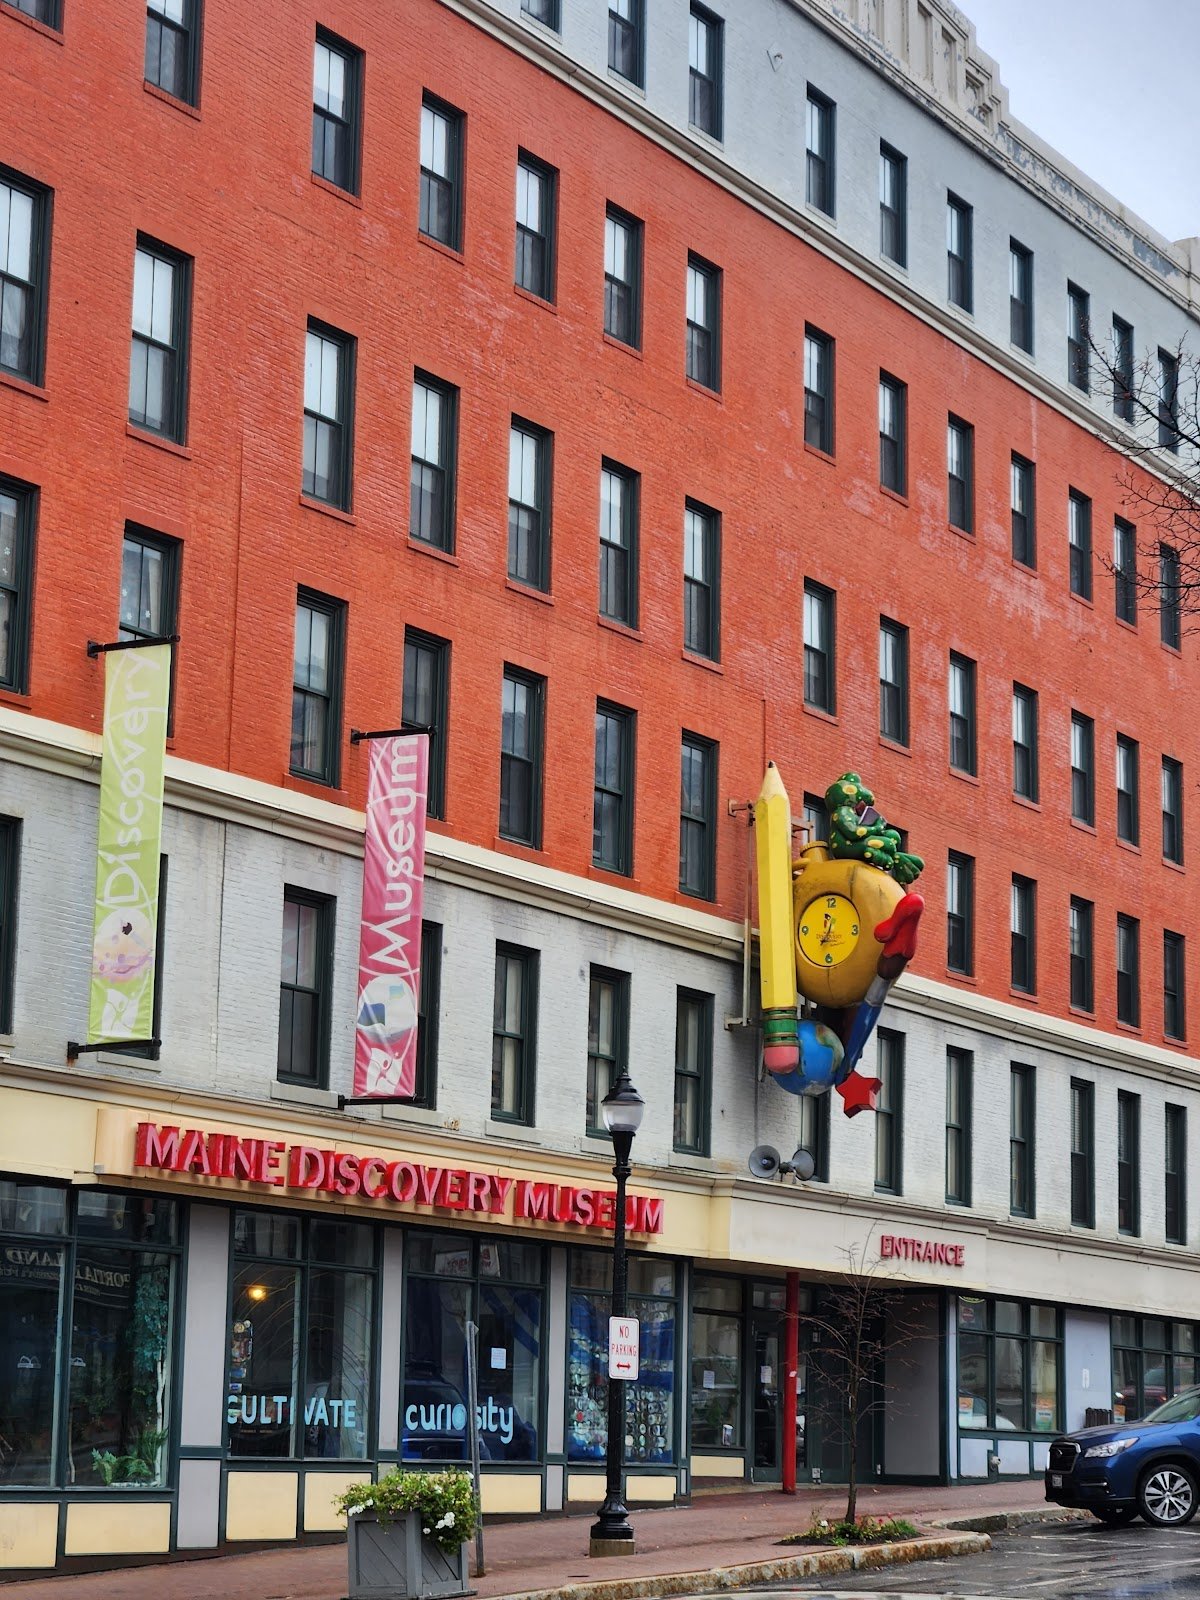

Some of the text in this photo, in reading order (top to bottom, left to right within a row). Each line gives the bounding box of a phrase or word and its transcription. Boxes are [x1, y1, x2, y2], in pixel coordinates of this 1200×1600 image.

[103, 650, 161, 906] Discovery
[368, 735, 418, 970] Museum
[826, 897, 837, 909] 12
[801, 925, 809, 936] 9
[851, 924, 859, 936] 3
[825, 953, 833, 964] 6
[134, 1121, 664, 1234] MAINE DISCOVERY MUSEUM
[881, 1234, 965, 1267] ENTRANCE
[618, 1325, 630, 1339] NO
[611, 1343, 637, 1357] PARKING
[227, 1394, 357, 1428] CULTIVATE
[405, 1396, 514, 1444] curiosity
